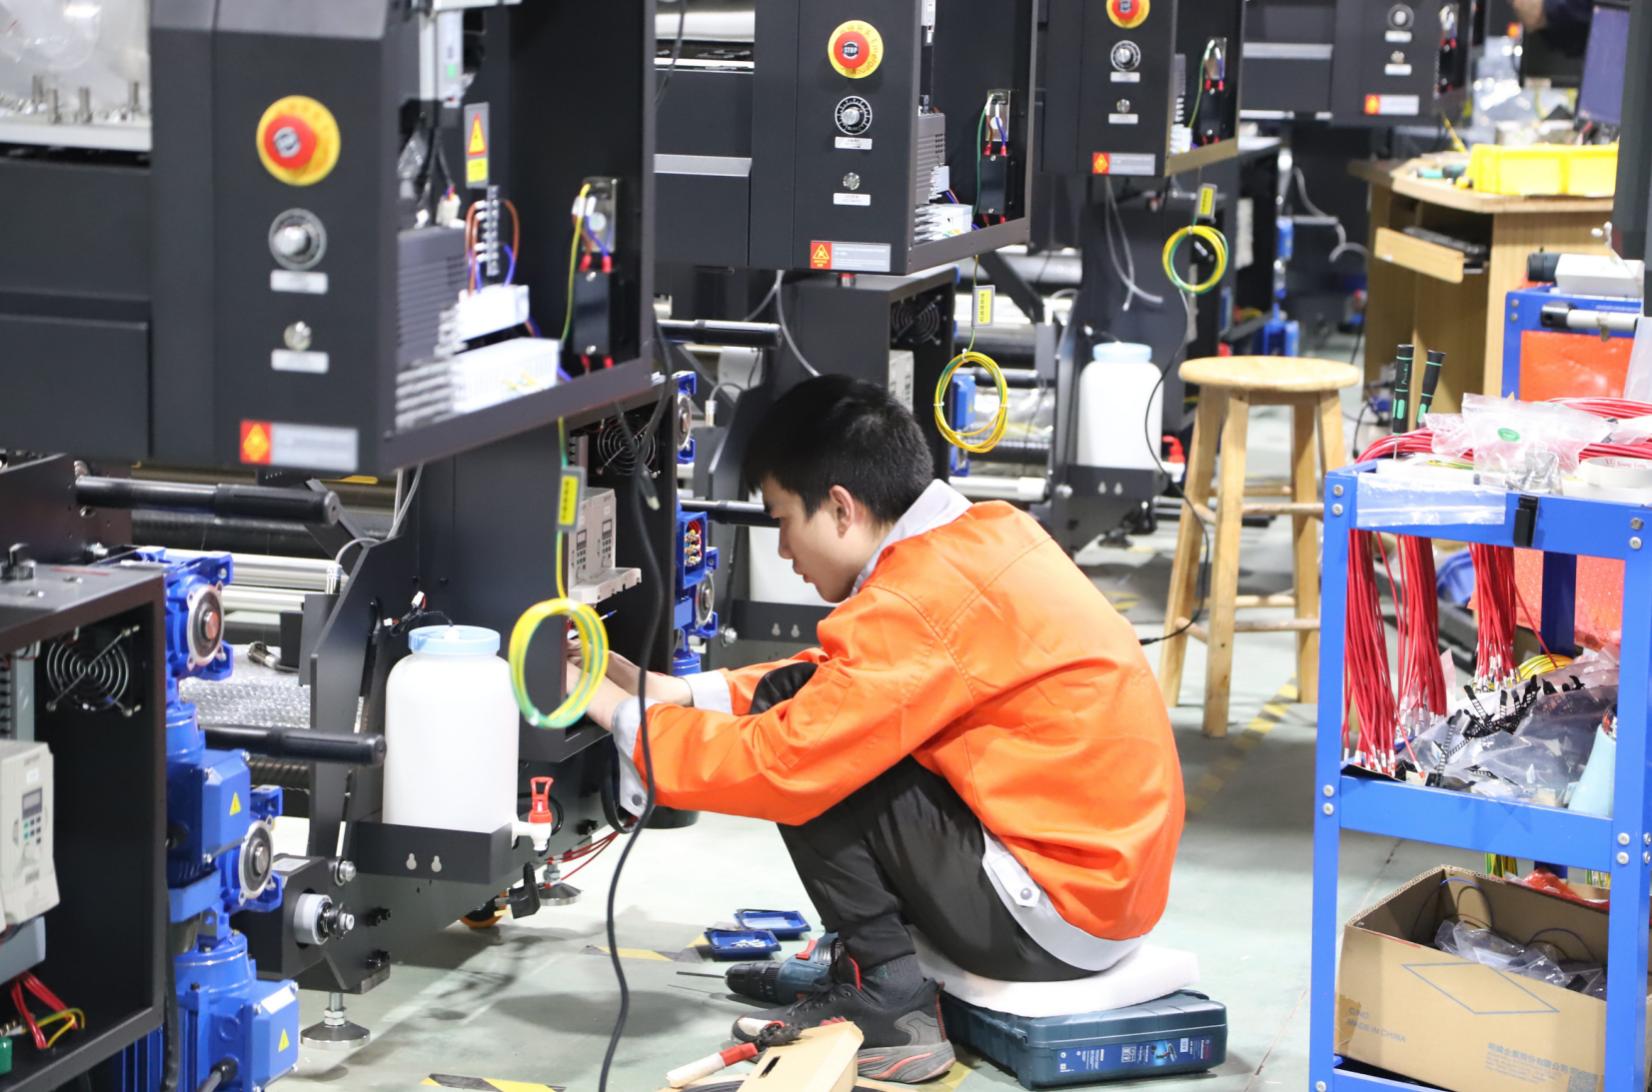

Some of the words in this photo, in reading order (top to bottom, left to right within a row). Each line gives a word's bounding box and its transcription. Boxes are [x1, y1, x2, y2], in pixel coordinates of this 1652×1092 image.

[843, 46, 858, 54] STOP
[1346, 1018, 1370, 1032] MADE
[1380, 1029, 1406, 1042] CHINA
